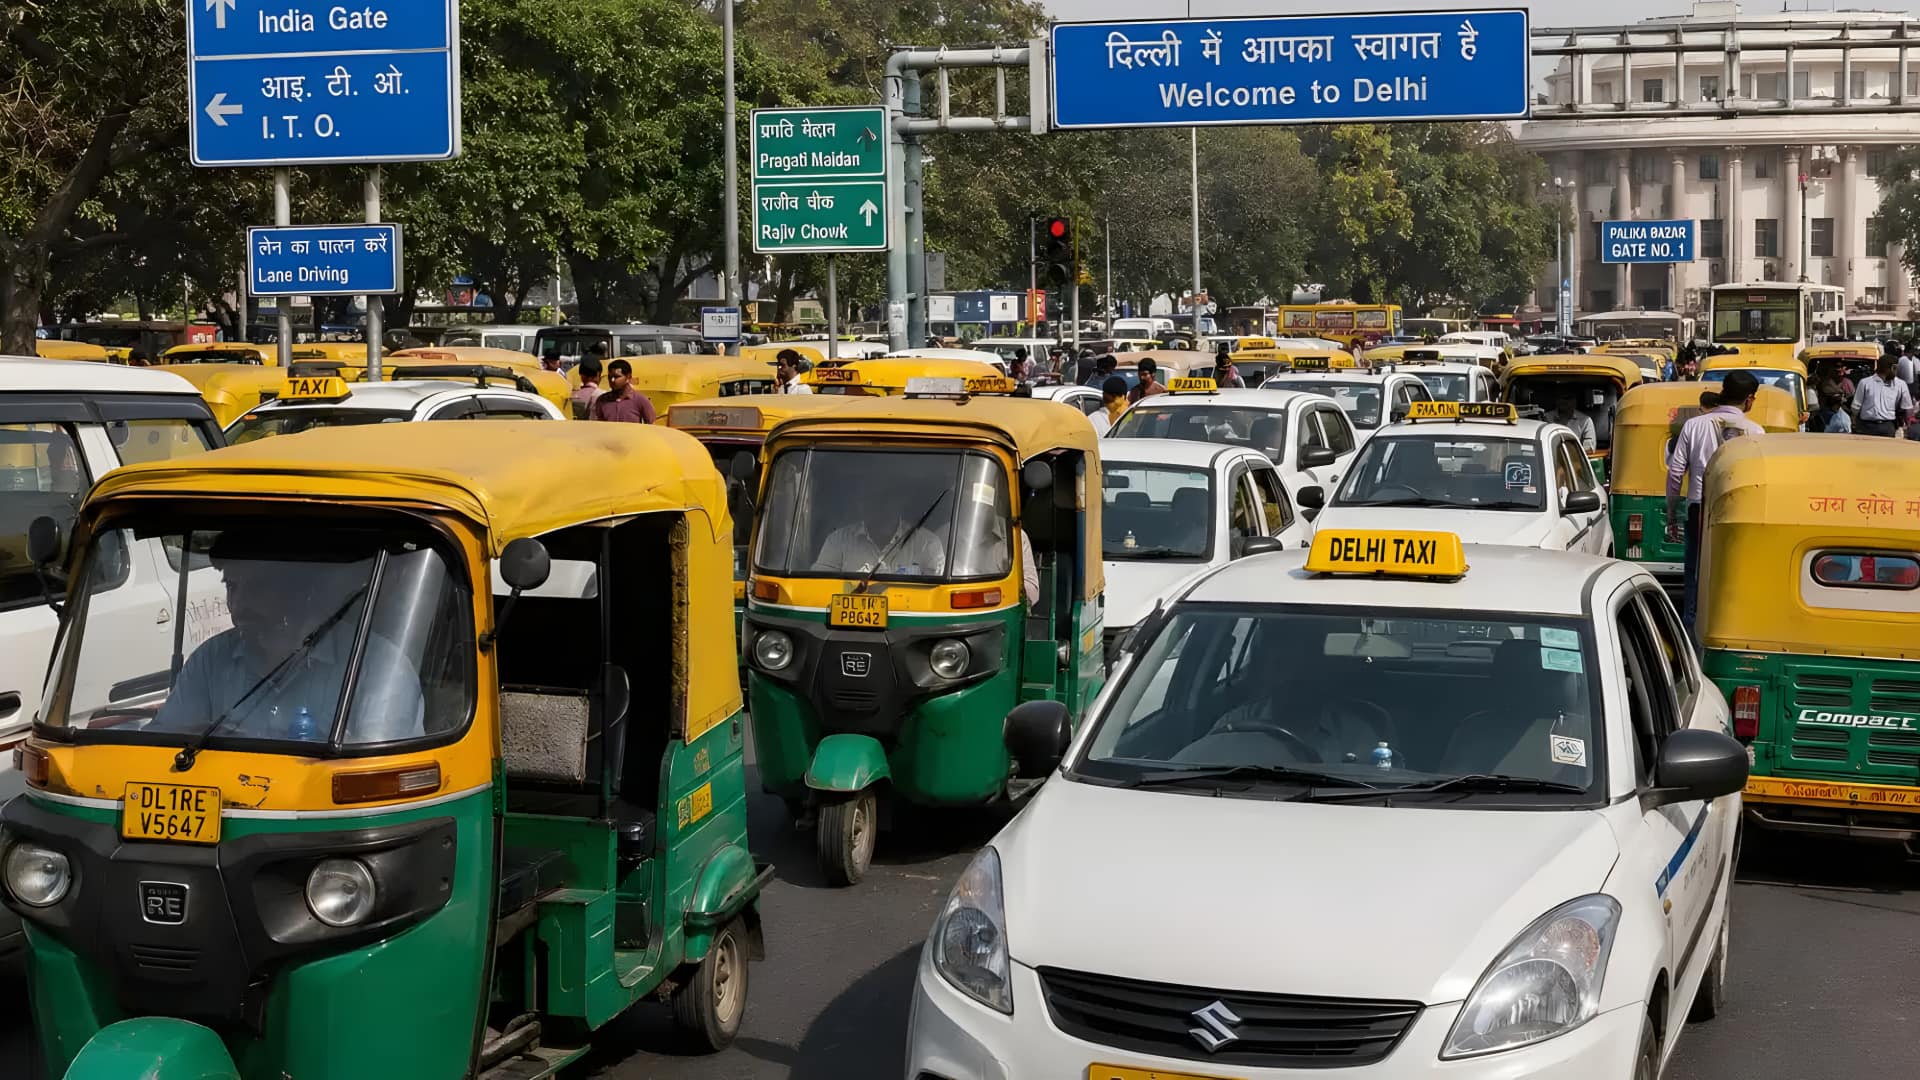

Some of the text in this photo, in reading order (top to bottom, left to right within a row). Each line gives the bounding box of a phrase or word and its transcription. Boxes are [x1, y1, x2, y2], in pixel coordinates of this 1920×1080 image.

[258, 6, 388, 33] India Gate
[1105, 19, 1479, 69] दिल्ली में आपका स्वागत है
[261, 64, 409, 102] आइ. टी. ओ.
[1159, 76, 1428, 108] Welcome to Delhi
[760, 151, 860, 171] Pragati Maidan
[761, 222, 848, 244] Rajiv Chowk
[1610, 226, 1686, 239] PALIKA BAZAR
[290, 240, 310, 255] का
[1612, 243, 1684, 257] GATE NO. 1
[258, 265, 349, 285] Lane Driving
[288, 379, 329, 395] TAXI
[1330, 537, 1437, 564] DELHI TAXI
[846, 661, 866, 672] RE
[1798, 709, 1917, 728] Compact
[141, 786, 207, 812] DL1RE
[140, 812, 206, 838] V5647
[147, 896, 182, 916] RE
